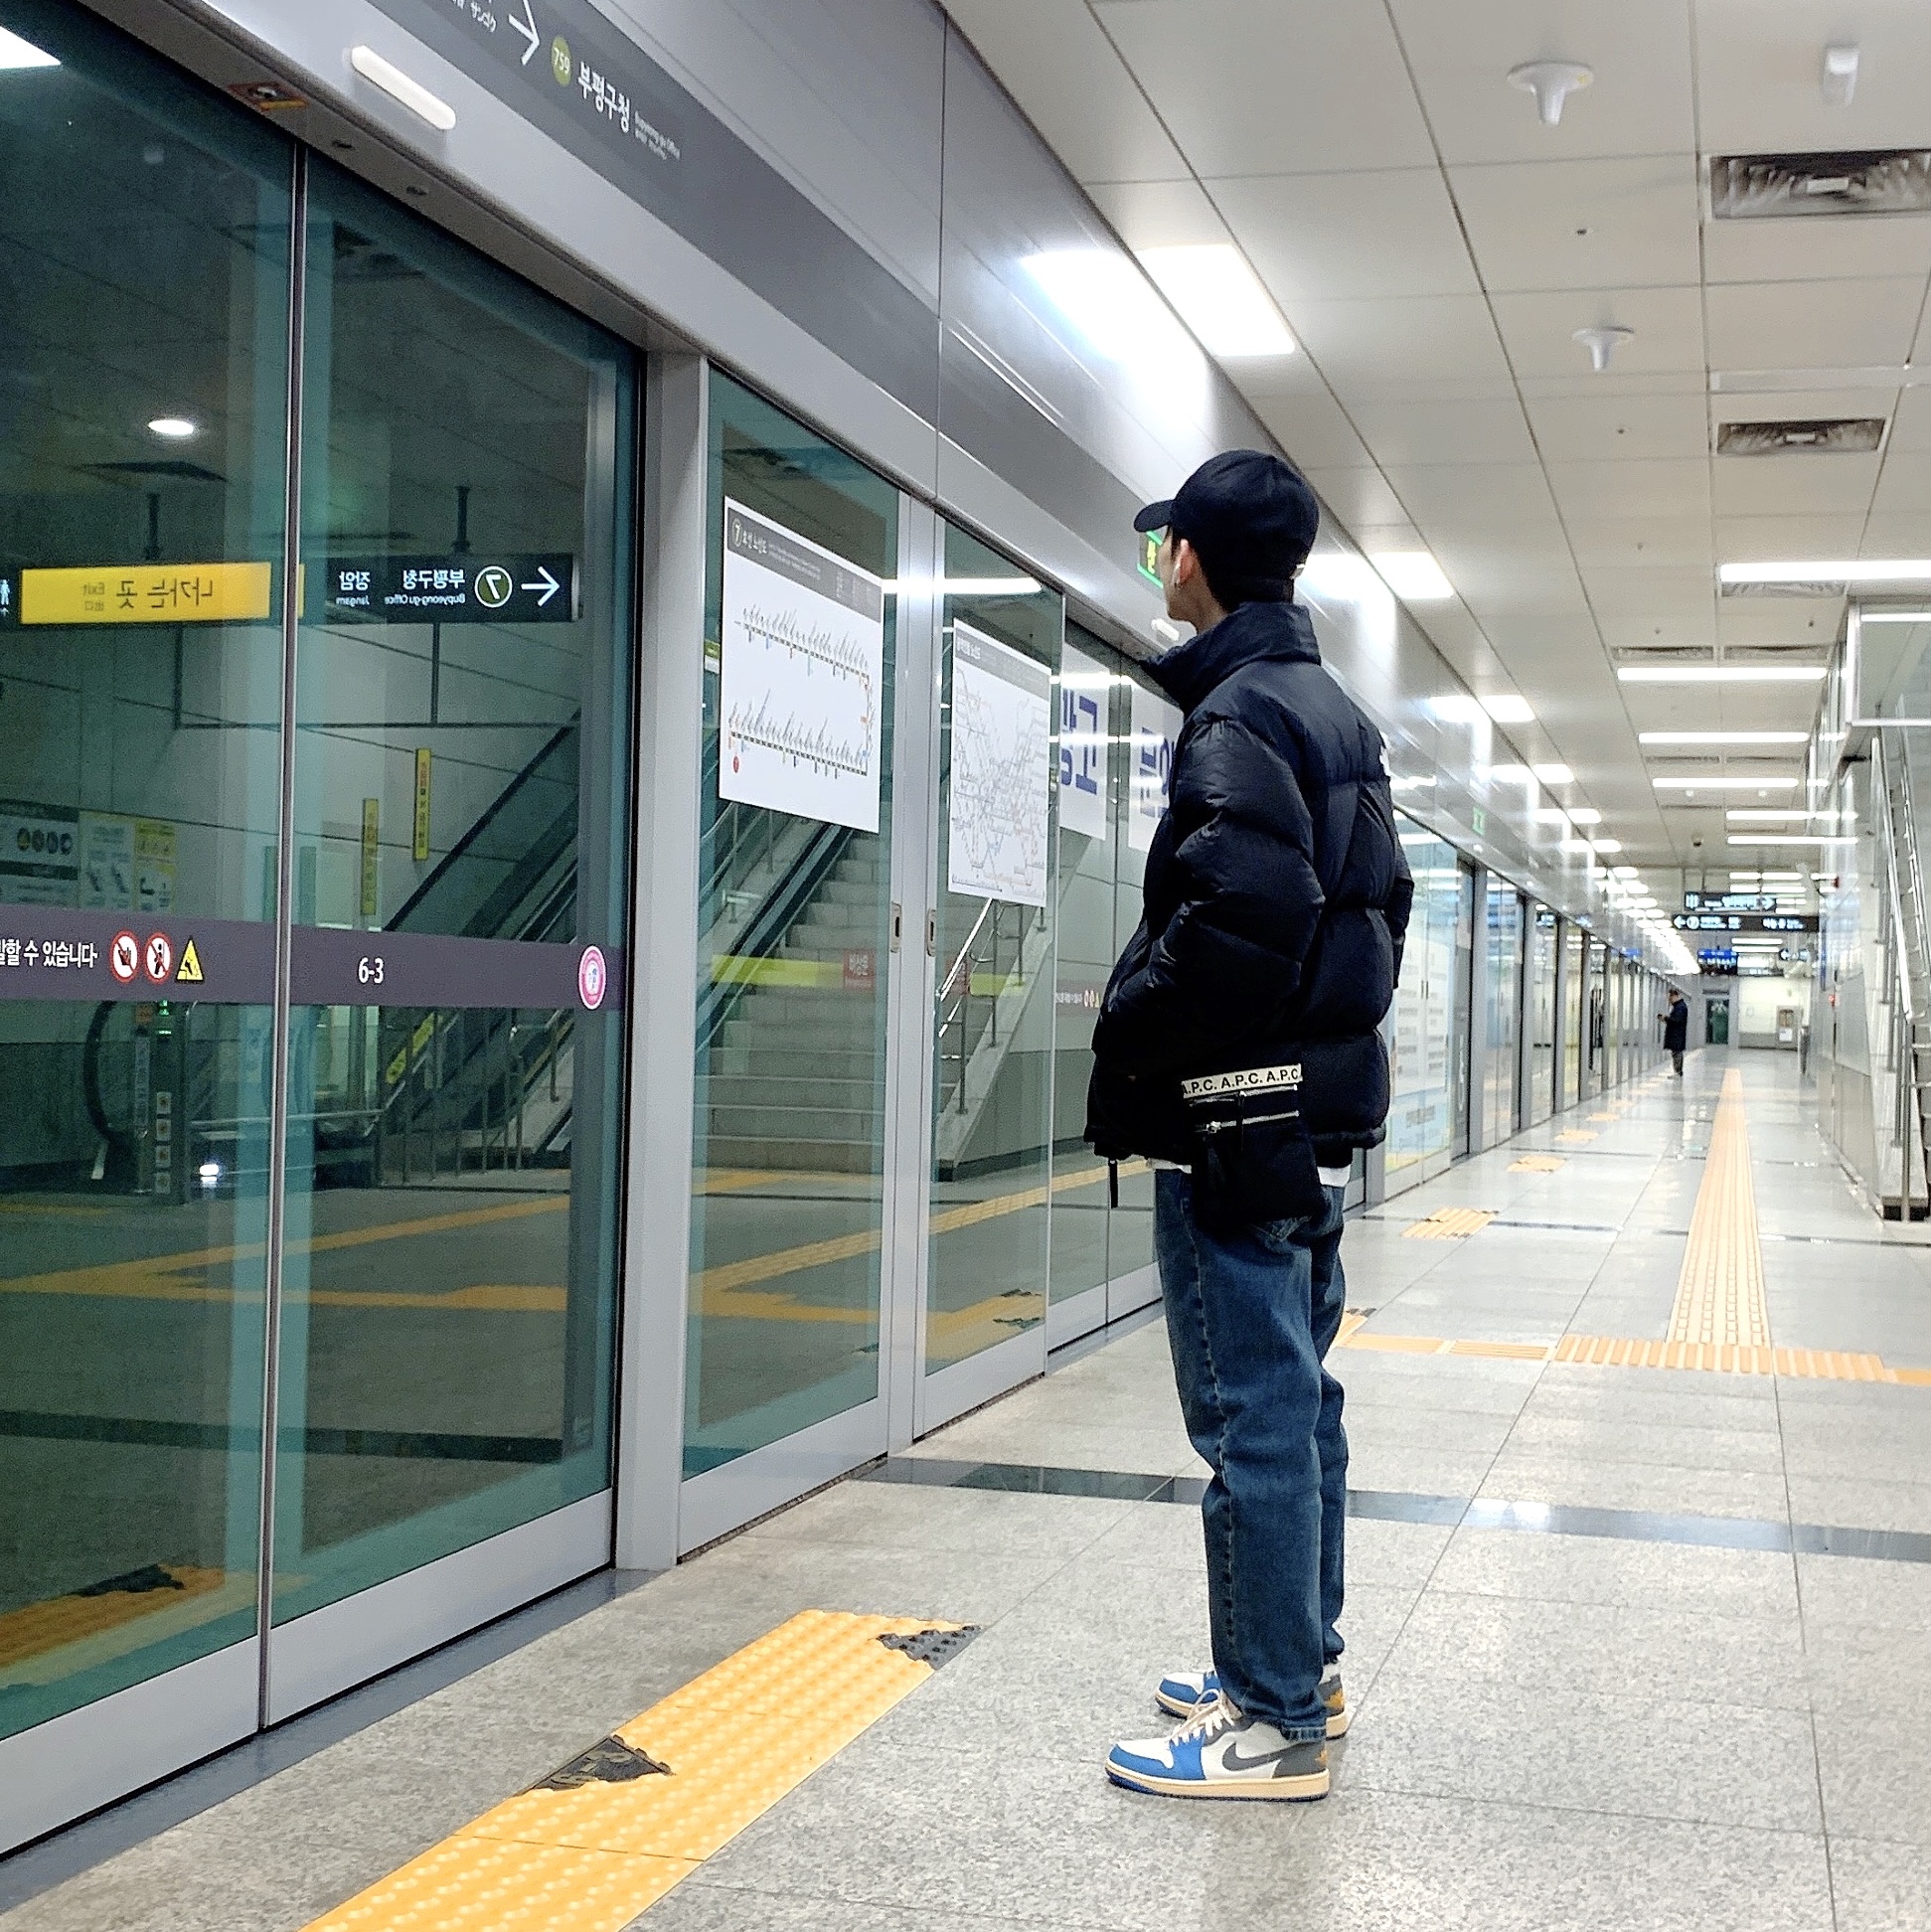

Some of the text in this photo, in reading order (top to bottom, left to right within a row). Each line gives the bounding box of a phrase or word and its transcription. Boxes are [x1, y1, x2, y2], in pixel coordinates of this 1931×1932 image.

[553, 47, 570, 75] 759
[578, 61, 631, 134] 부평구청
[23, 939, 40, 967] 수
[42, 940, 98, 968] 있습니다
[358, 957, 385, 984] 6-3
[1220, 1072, 1263, 1089] A.P.C.
